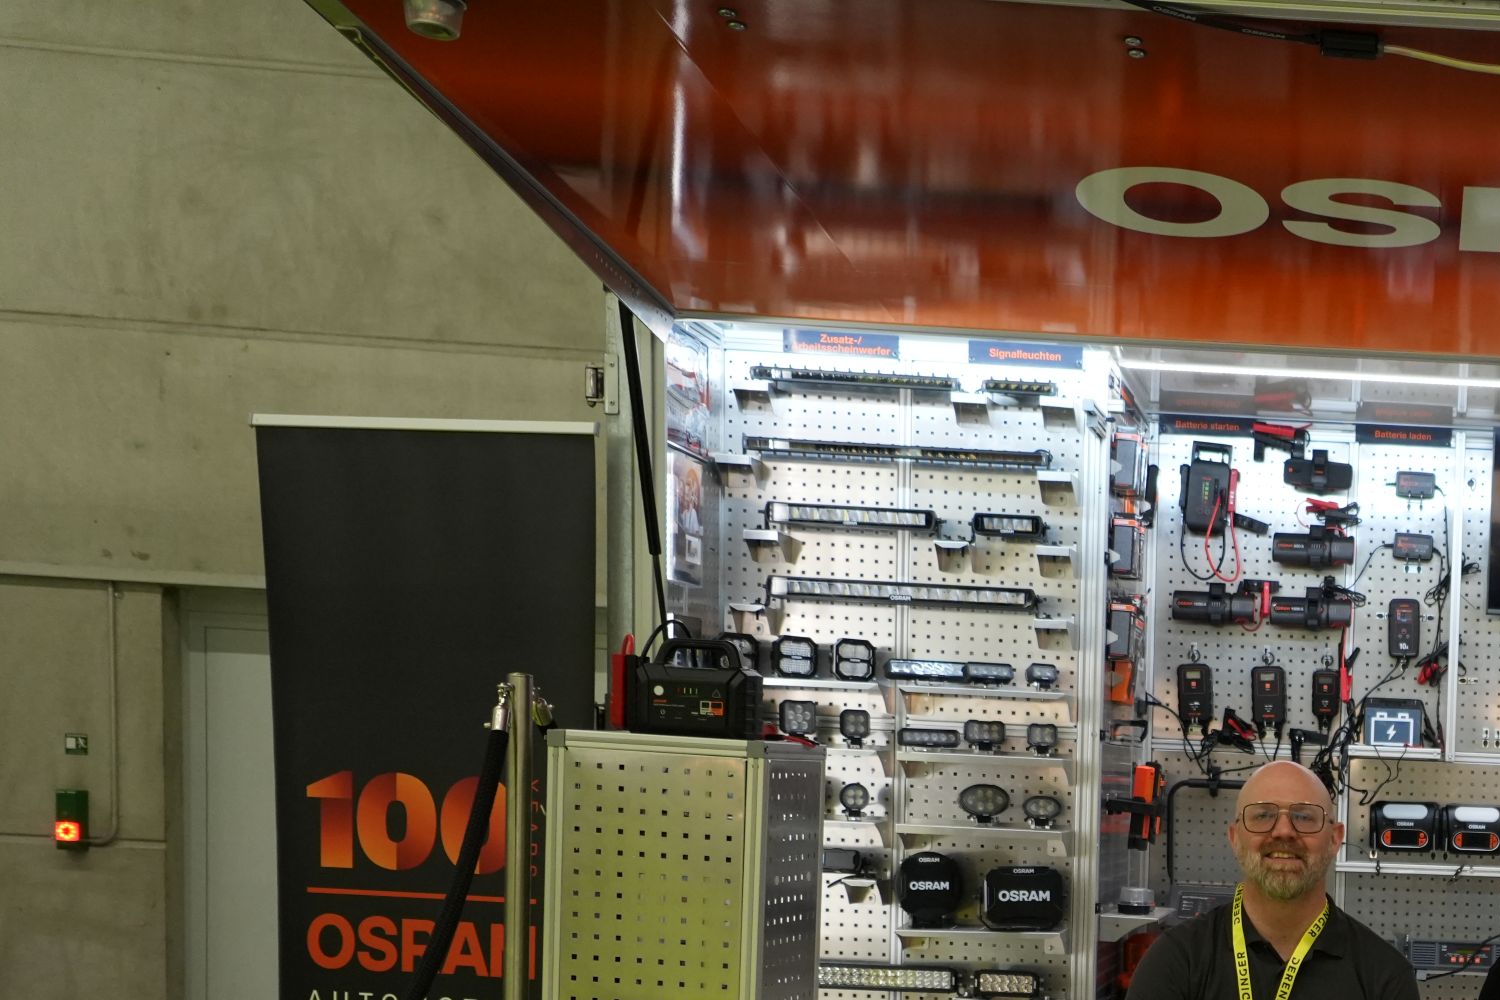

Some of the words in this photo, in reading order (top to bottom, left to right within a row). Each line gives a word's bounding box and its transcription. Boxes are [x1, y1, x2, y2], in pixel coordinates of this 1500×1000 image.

[989, 347, 1062, 362] Signalleuchten
[1175, 420, 1208, 430] Batterie
[1210, 421, 1240, 431] starten
[1375, 430, 1407, 439] Batterie
[1409, 431, 1432, 440] laden
[909, 881, 950, 891] OSRAM
[998, 890, 1051, 902] OSRAM
